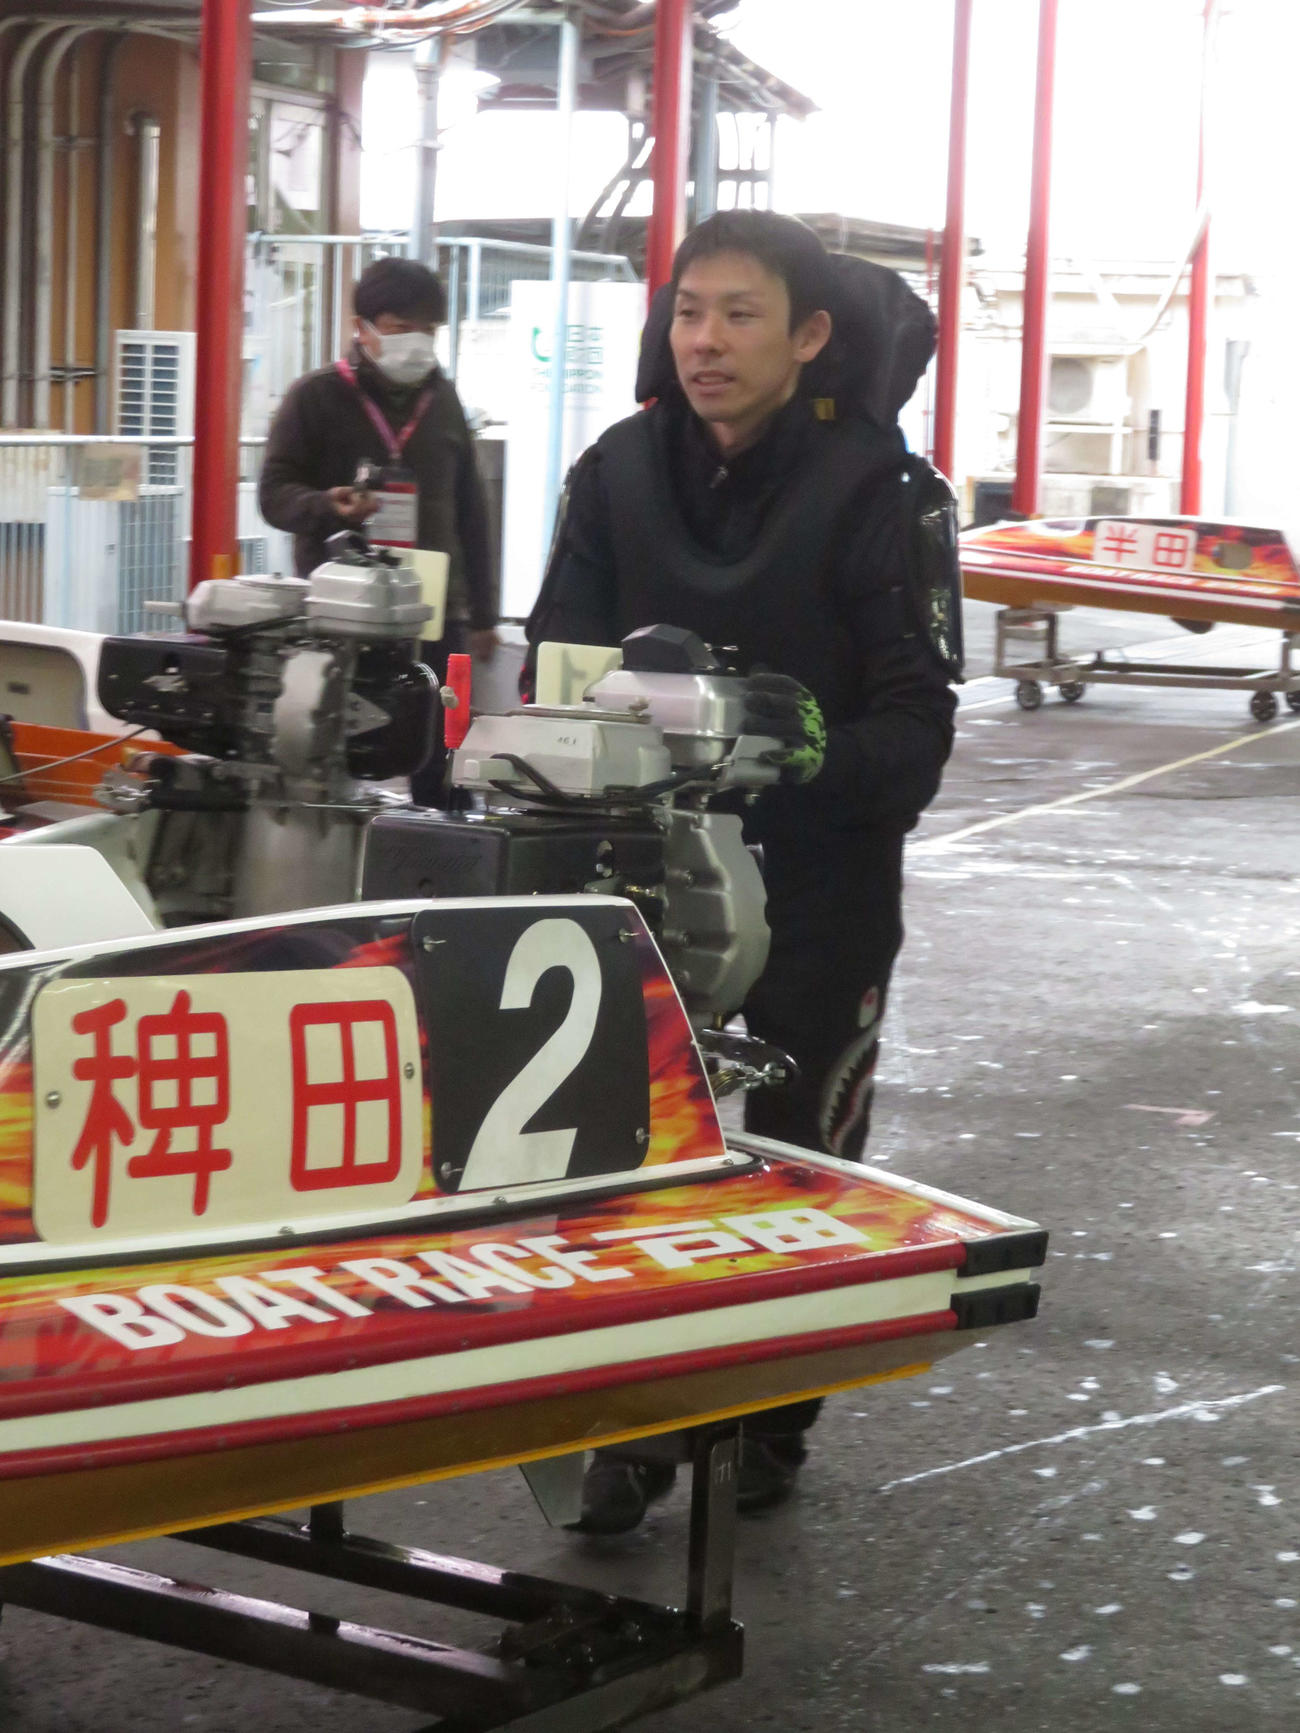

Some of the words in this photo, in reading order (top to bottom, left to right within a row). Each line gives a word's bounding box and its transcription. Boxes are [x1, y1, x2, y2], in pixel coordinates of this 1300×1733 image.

[1102, 525, 1189, 569] 半田
[457, 918, 602, 1192] 2
[57, 1265, 373, 1350] BOAT
[342, 1235, 634, 1308] RACE
[591, 1207, 872, 1269] 戸田
